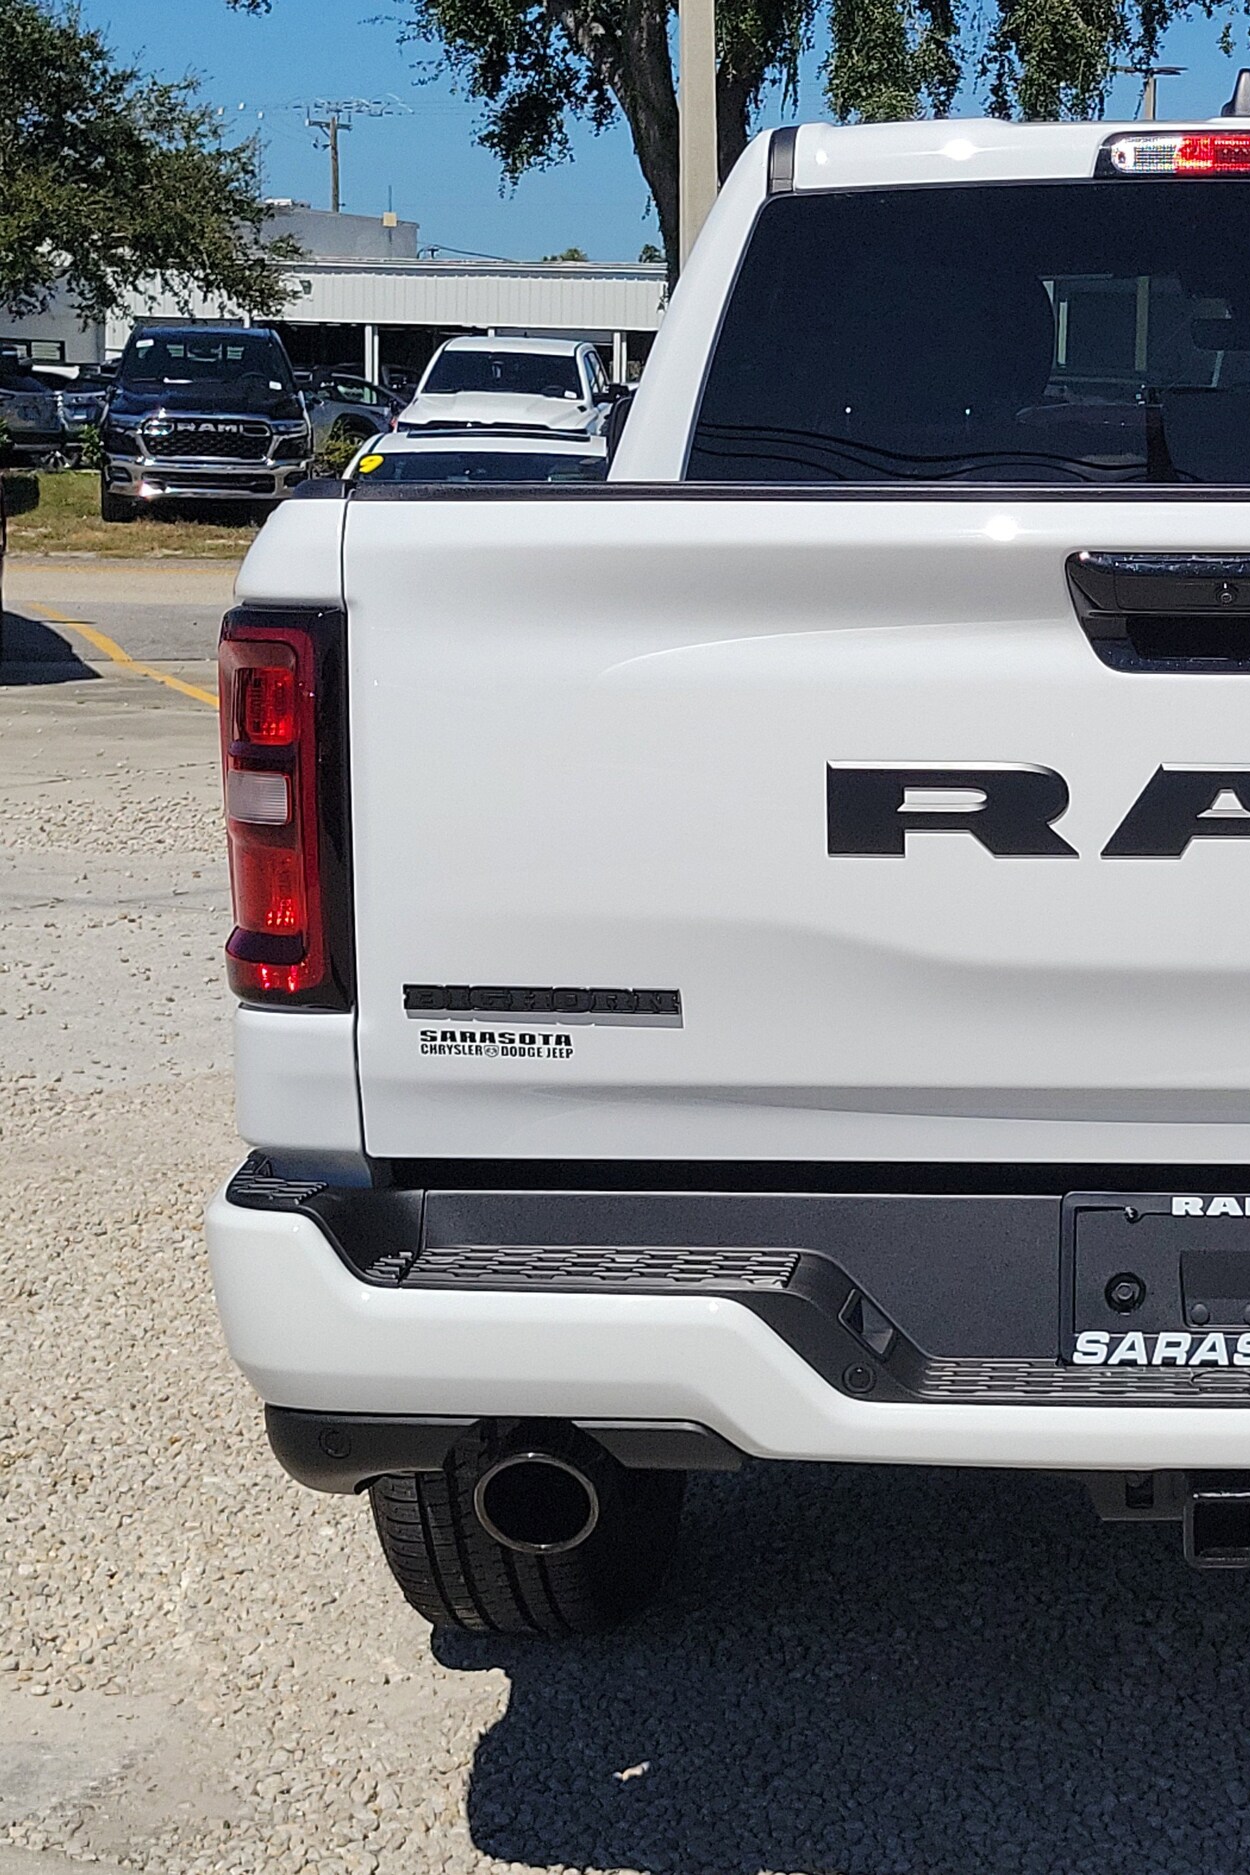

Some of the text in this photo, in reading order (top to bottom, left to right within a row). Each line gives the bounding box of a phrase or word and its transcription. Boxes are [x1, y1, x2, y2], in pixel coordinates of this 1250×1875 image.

[177, 422, 238, 433] RAM
[402, 984, 682, 1015] BIGHORN
[420, 1030, 572, 1046] SARASOTA
[420, 1044, 574, 1059] CHRYSLER DODGE JEEP
